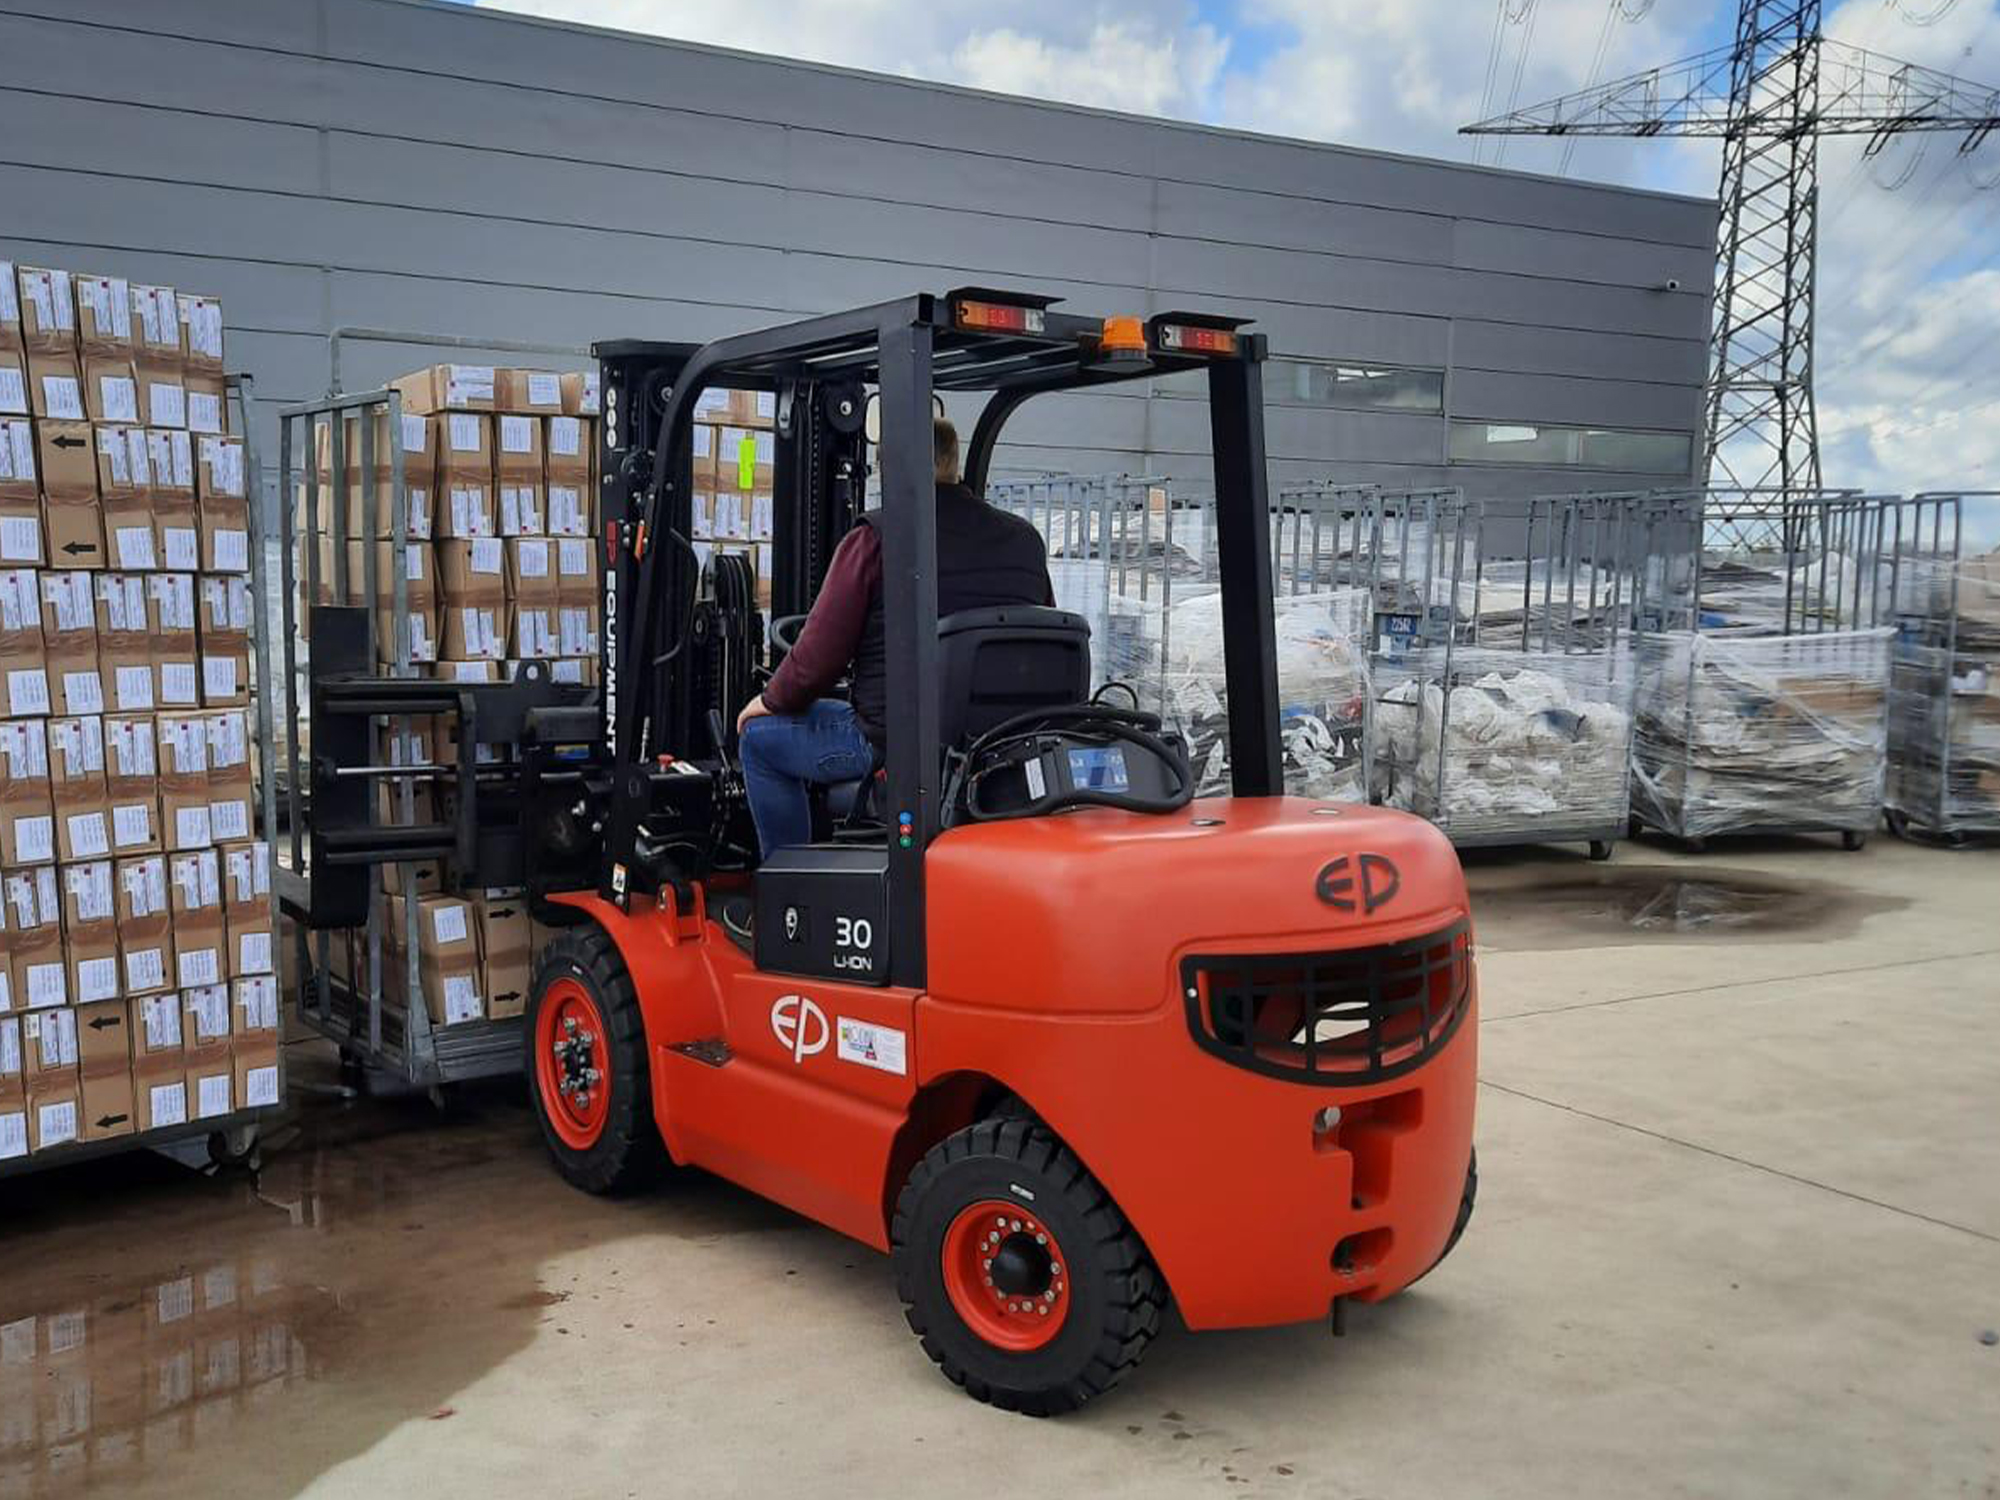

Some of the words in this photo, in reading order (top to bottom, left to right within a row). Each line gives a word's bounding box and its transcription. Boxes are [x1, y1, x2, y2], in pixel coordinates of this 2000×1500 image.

[606, 570, 617, 757] EQUIPMENT
[1315, 853, 1400, 916] EP
[835, 917, 873, 949] 30
[771, 995, 830, 1064] EP
